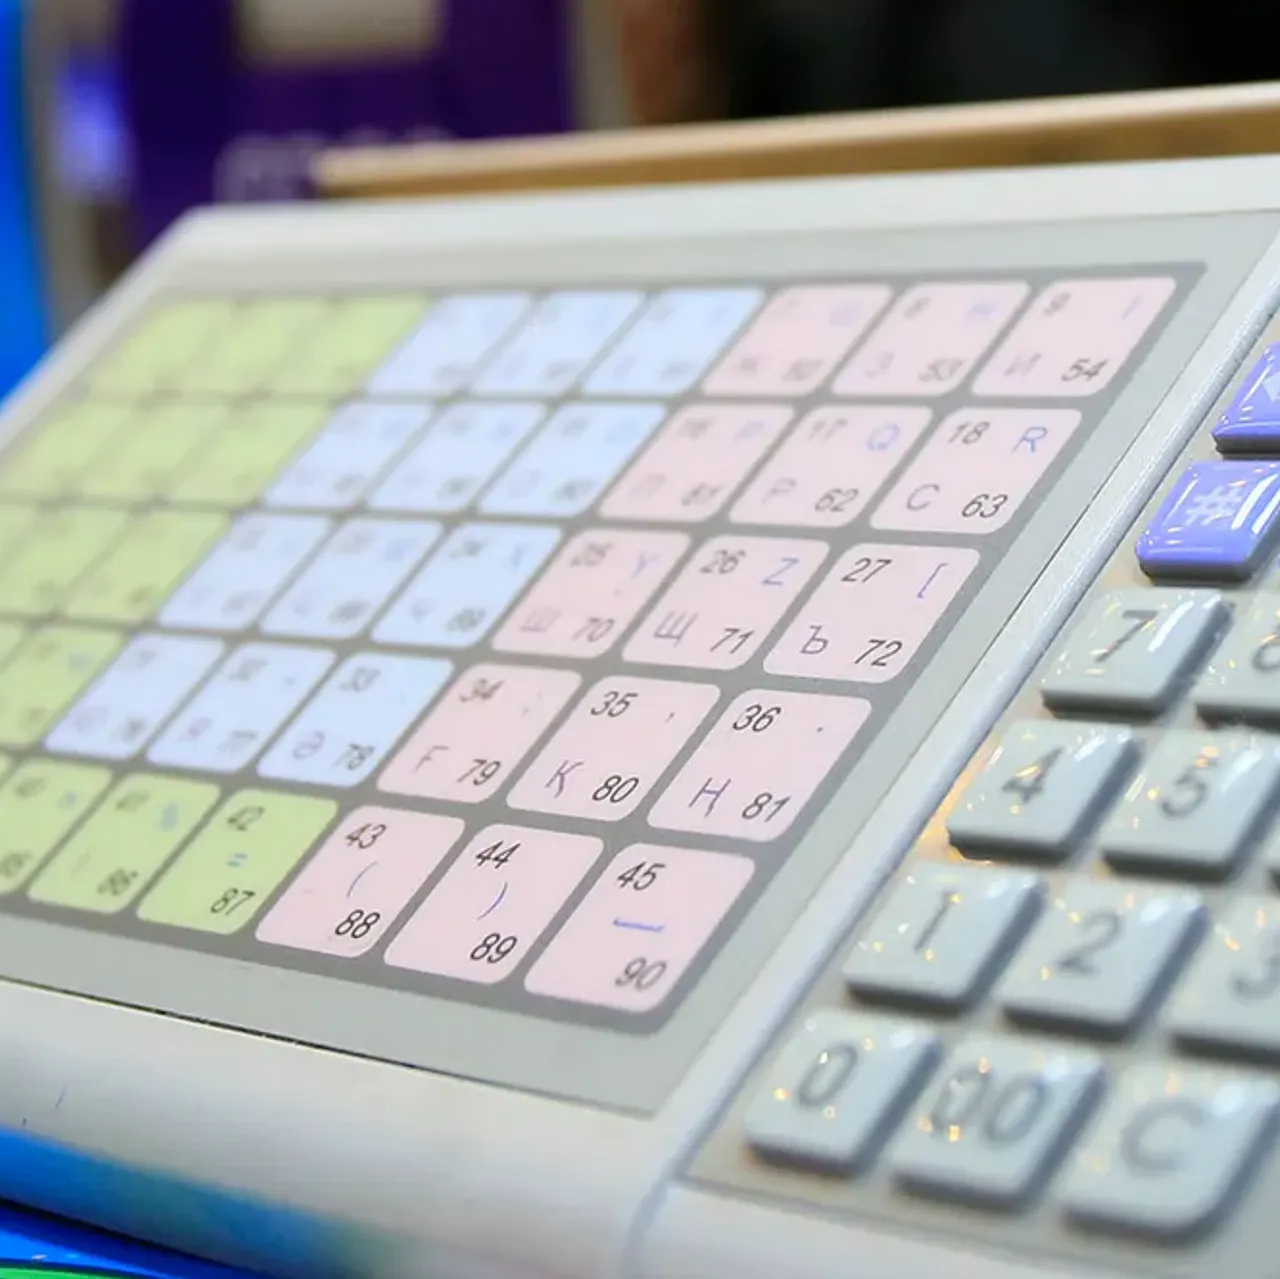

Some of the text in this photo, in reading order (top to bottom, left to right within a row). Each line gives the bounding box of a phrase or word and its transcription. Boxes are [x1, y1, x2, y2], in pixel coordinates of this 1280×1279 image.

[1060, 357, 1110, 382] 54
[866, 422, 901, 452] Q
[947, 420, 1049, 455] 18 R
[813, 487, 860, 514] 62
[960, 492, 1010, 520] 63
[698, 548, 800, 587] 26 Z
[840, 556, 893, 584] 27
[571, 616, 615, 644] 70
[652, 610, 755, 655] Щ 71
[1093, 609, 1158, 664] 7
[799, 624, 904, 668] Ъ 72
[459, 677, 505, 703] 34
[590, 690, 639, 719] 35
[731, 703, 782, 734] 36
[330, 741, 376, 772] 78
[455, 758, 502, 787] 79
[998, 746, 1066, 805] 4
[1160, 754, 1214, 818] 5
[591, 774, 640, 804] 80
[226, 805, 267, 832] 42
[741, 791, 793, 823] 81
[344, 822, 388, 851] 43
[474, 839, 522, 870] 44
[616, 860, 667, 891] 45
[209, 887, 257, 917] 87
[333, 908, 382, 940] 88
[912, 888, 956, 951] 1
[468, 931, 519, 965] 89
[1054, 907, 1122, 975] 2
[613, 956, 669, 993] 90
[797, 1042, 860, 1108] 0
